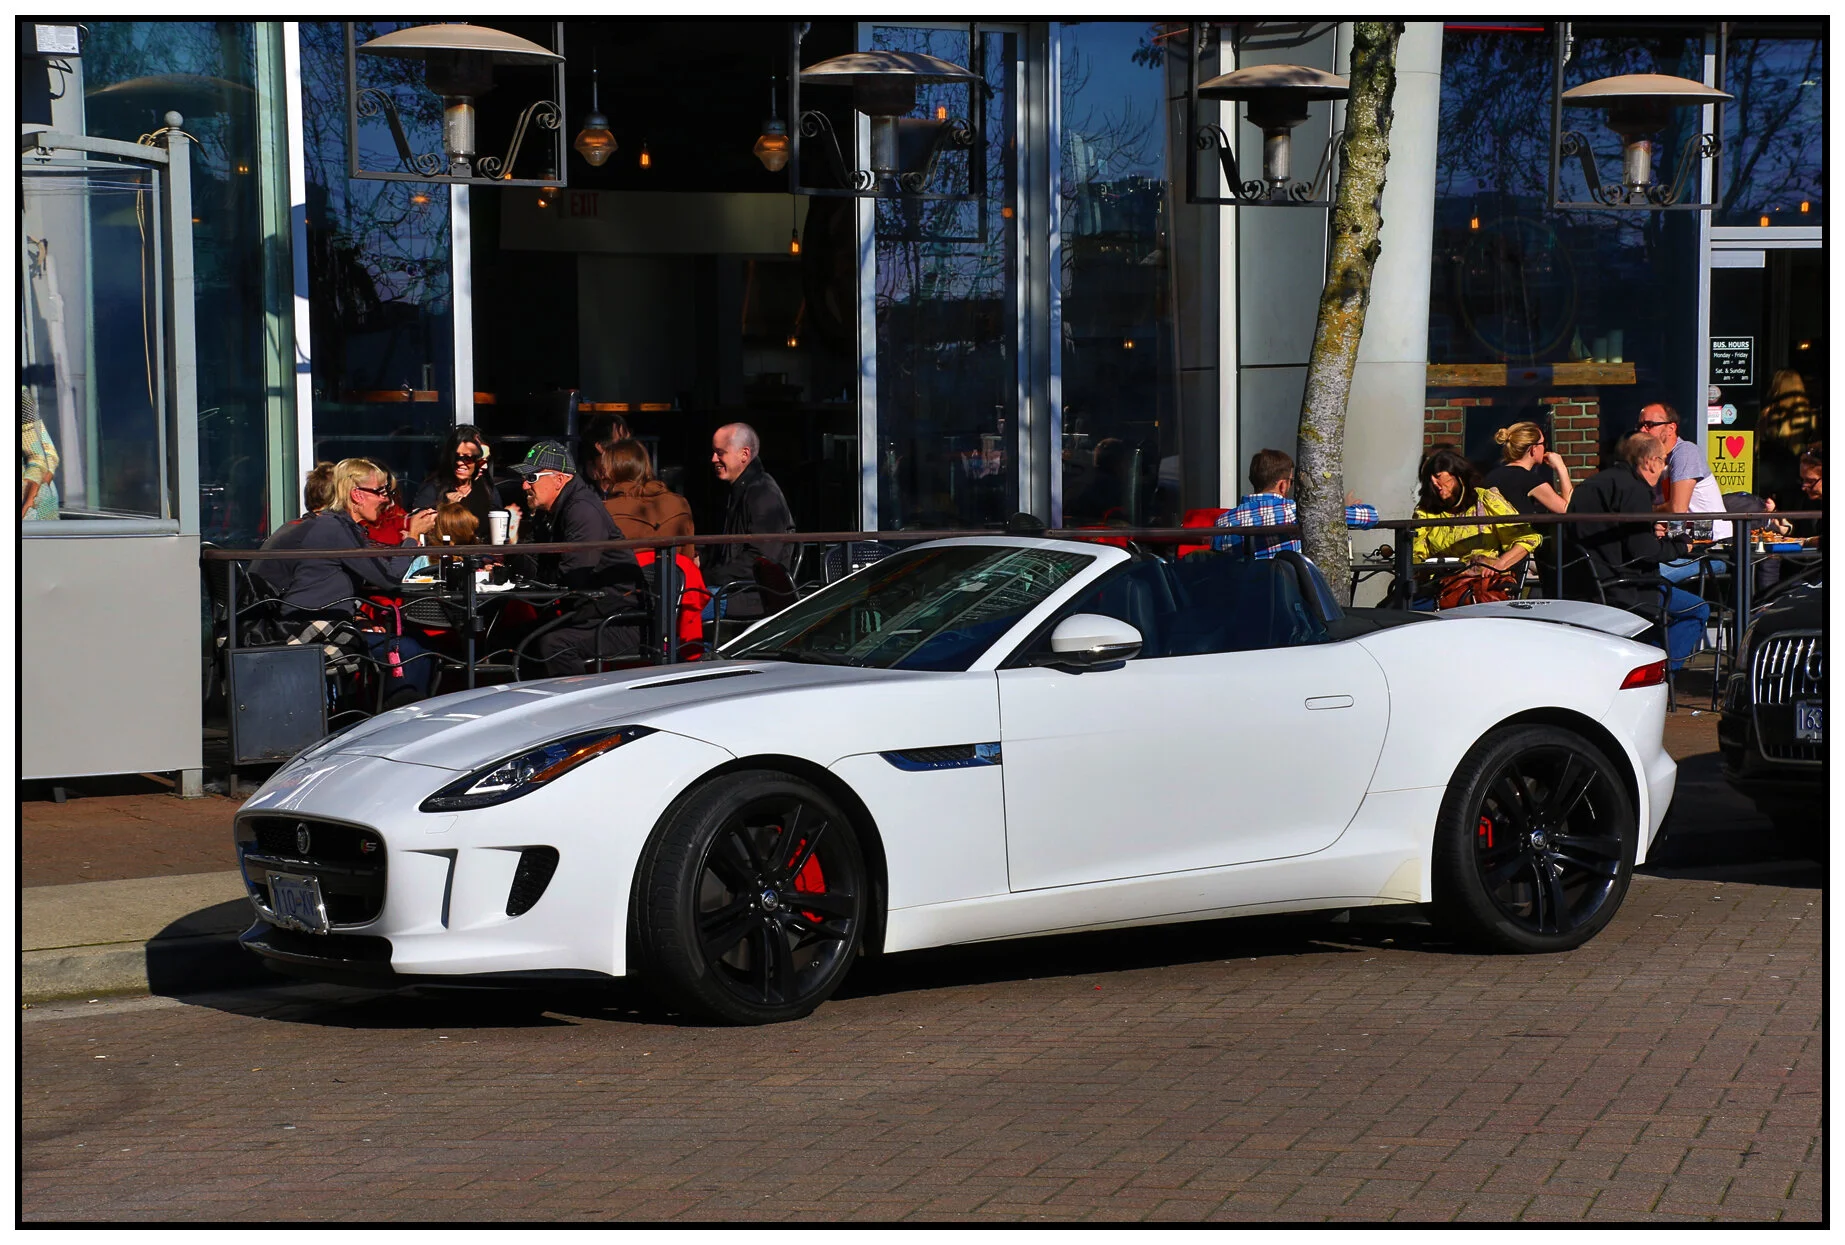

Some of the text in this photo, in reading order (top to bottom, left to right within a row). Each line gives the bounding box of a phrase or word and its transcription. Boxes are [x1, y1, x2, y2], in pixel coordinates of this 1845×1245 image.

[570, 192, 600, 217] EXIT
[1734, 351, 1748, 359] Friday
[1729, 367, 1746, 375] Sunday
[1715, 435, 1726, 460] I
[1712, 461, 1746, 473] YALE
